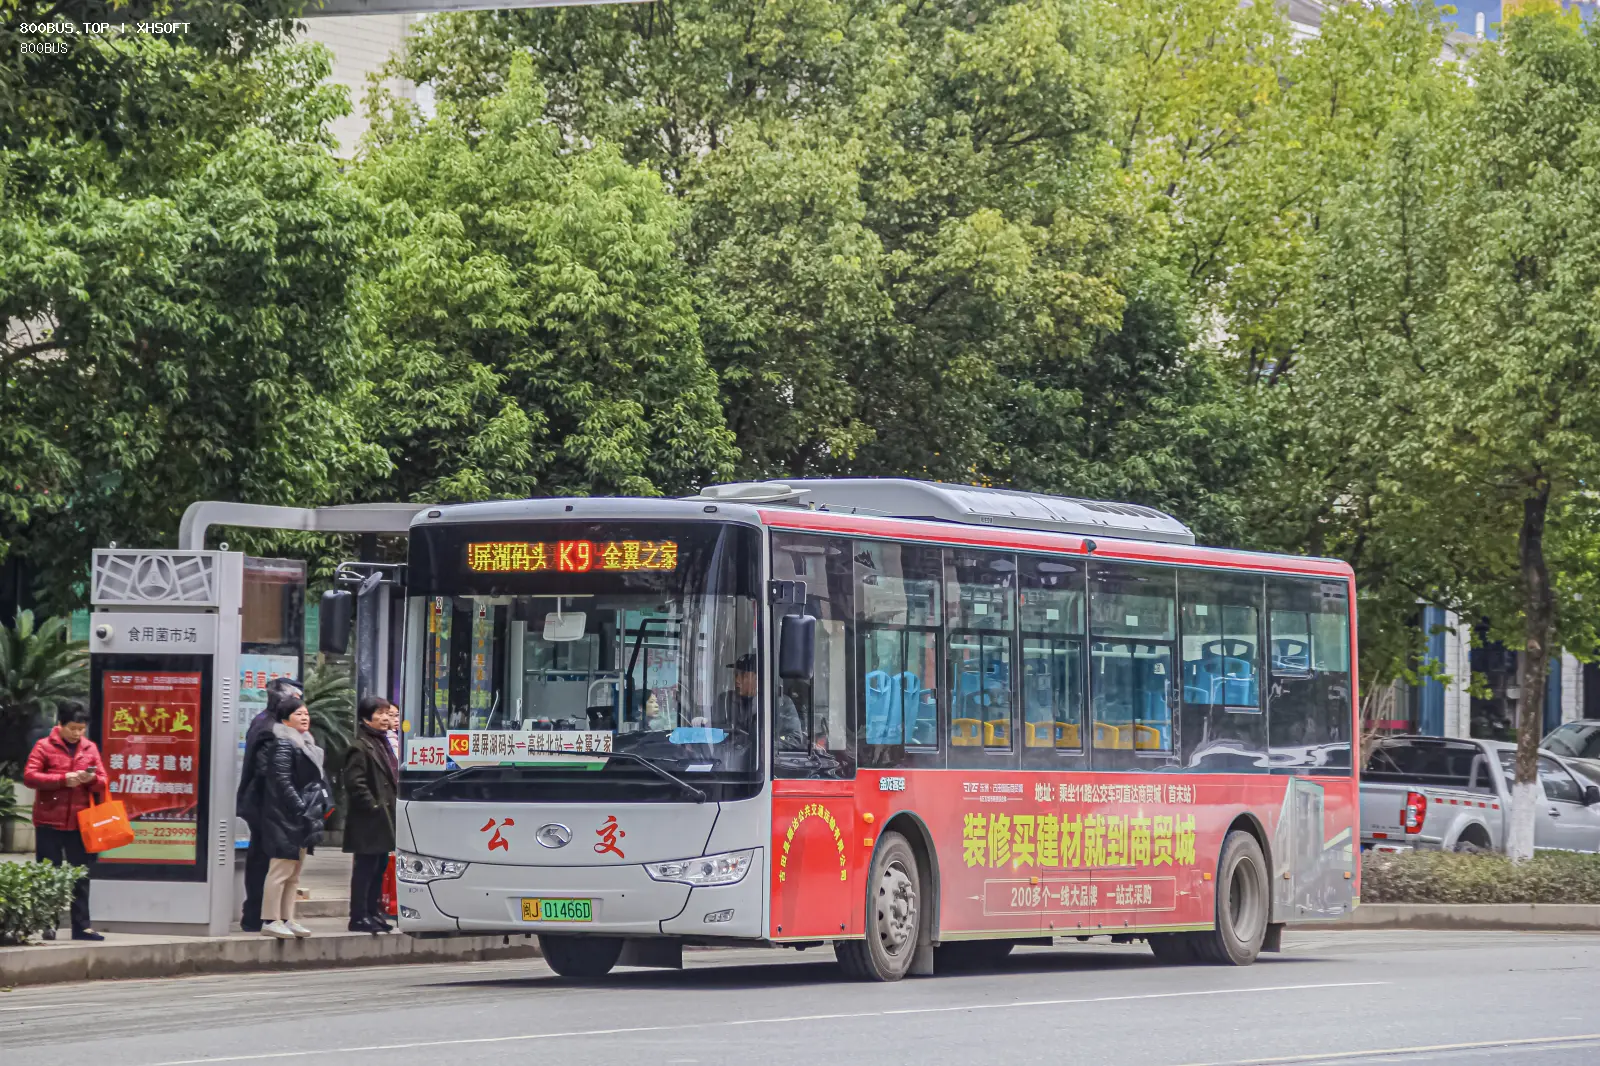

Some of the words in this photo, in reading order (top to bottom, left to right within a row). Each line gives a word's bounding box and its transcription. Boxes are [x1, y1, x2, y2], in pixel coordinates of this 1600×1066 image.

[468, 542, 547, 571] 屏湖码头
[560, 542, 590, 571] K9
[603, 541, 678, 570] 金翼之家
[128, 626, 198, 643] 食用菌市场
[112, 707, 193, 733] 盛大开业
[408, 746, 445, 766] 上车3元
[450, 737, 469, 752] K9
[472, 733, 515, 756] 翠屏湖码头
[109, 753, 193, 771] 装修买建材
[480, 817, 515, 852] 公
[593, 815, 626, 859] 交
[962, 812, 1197, 868] 装修买建材就到商贸城
[1010, 885, 1098, 907] 200多个一线大品牌
[1106, 884, 1153, 905] 一站式采购
